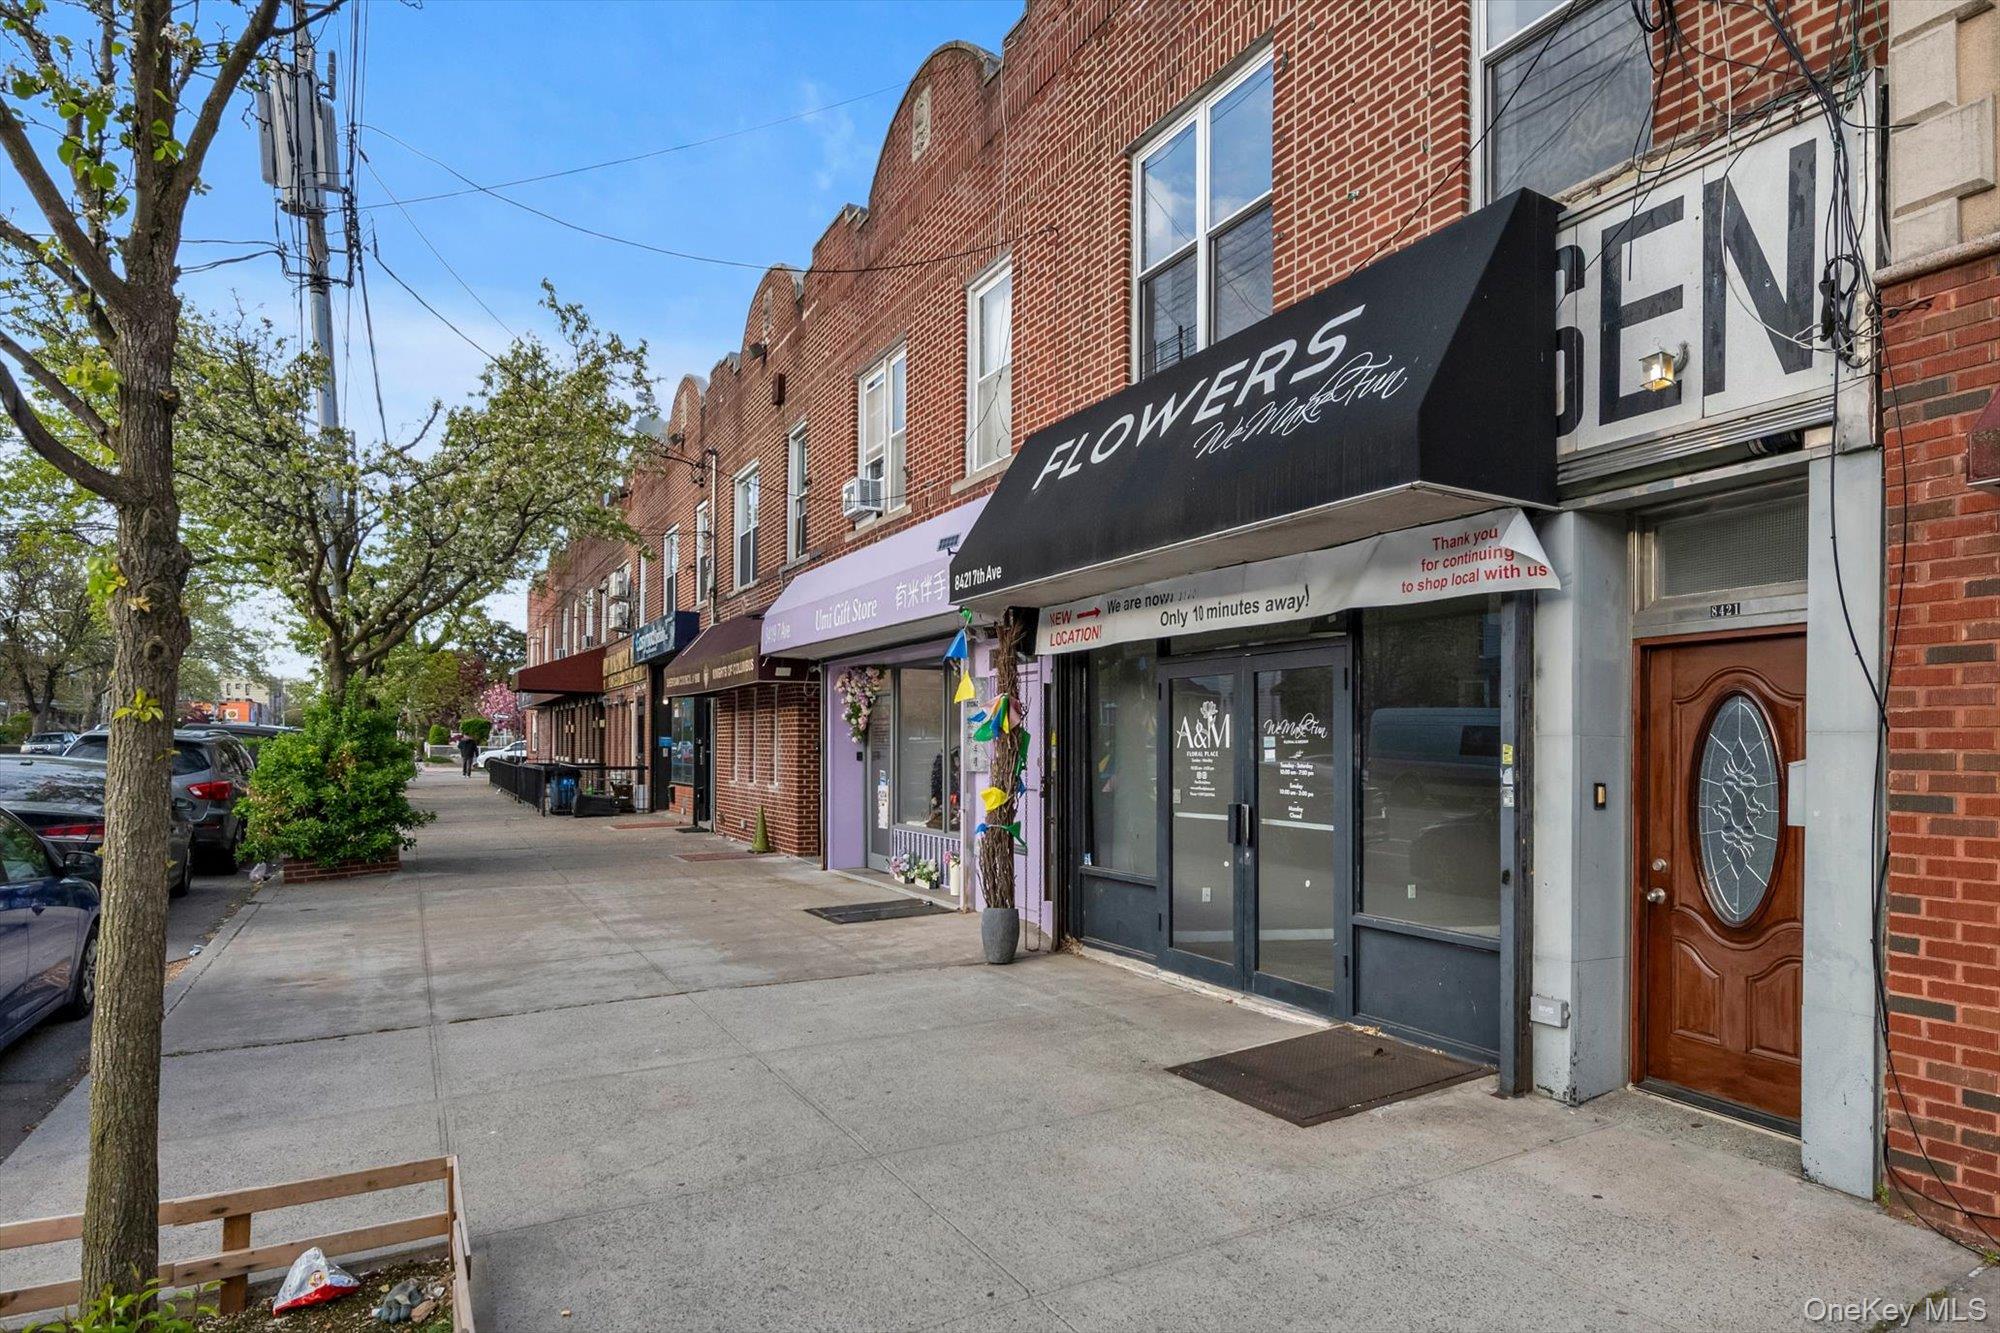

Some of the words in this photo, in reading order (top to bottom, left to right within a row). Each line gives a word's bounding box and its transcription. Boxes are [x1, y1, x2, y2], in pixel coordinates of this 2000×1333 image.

[1031, 303, 1367, 491] FLOWERS
[1193, 416, 1244, 459] We
[1432, 529, 1470, 551] Thank
[1472, 527, 1499, 546] you
[1421, 557, 1440, 572] for
[1442, 545, 1515, 569] continuing
[954, 571, 972, 591] 8421
[973, 567, 985, 586] 7th
[986, 565, 1002, 582] Ave
[1401, 580, 1414, 593] to
[1417, 577, 1448, 592] shop
[1451, 568, 1480, 586] local
[1484, 564, 1521, 581] with
[1527, 565, 1548, 578] us
[815, 606, 832, 631] Umi
[833, 600, 851, 626] Gift
[852, 598, 878, 622] Store
[1049, 610, 1073, 627] NEW
[1107, 599, 1122, 615] We
[1123, 597, 1142, 611] are
[1160, 608, 1188, 628] Only
[1193, 605, 1204, 622] 10
[1206, 598, 1260, 619] minutes
[1265, 584, 1310, 613] away!
[1711, 603, 1740, 617] 8421
[1049, 625, 1102, 647] LOCATION!
[1176, 713, 1230, 748] A&M
